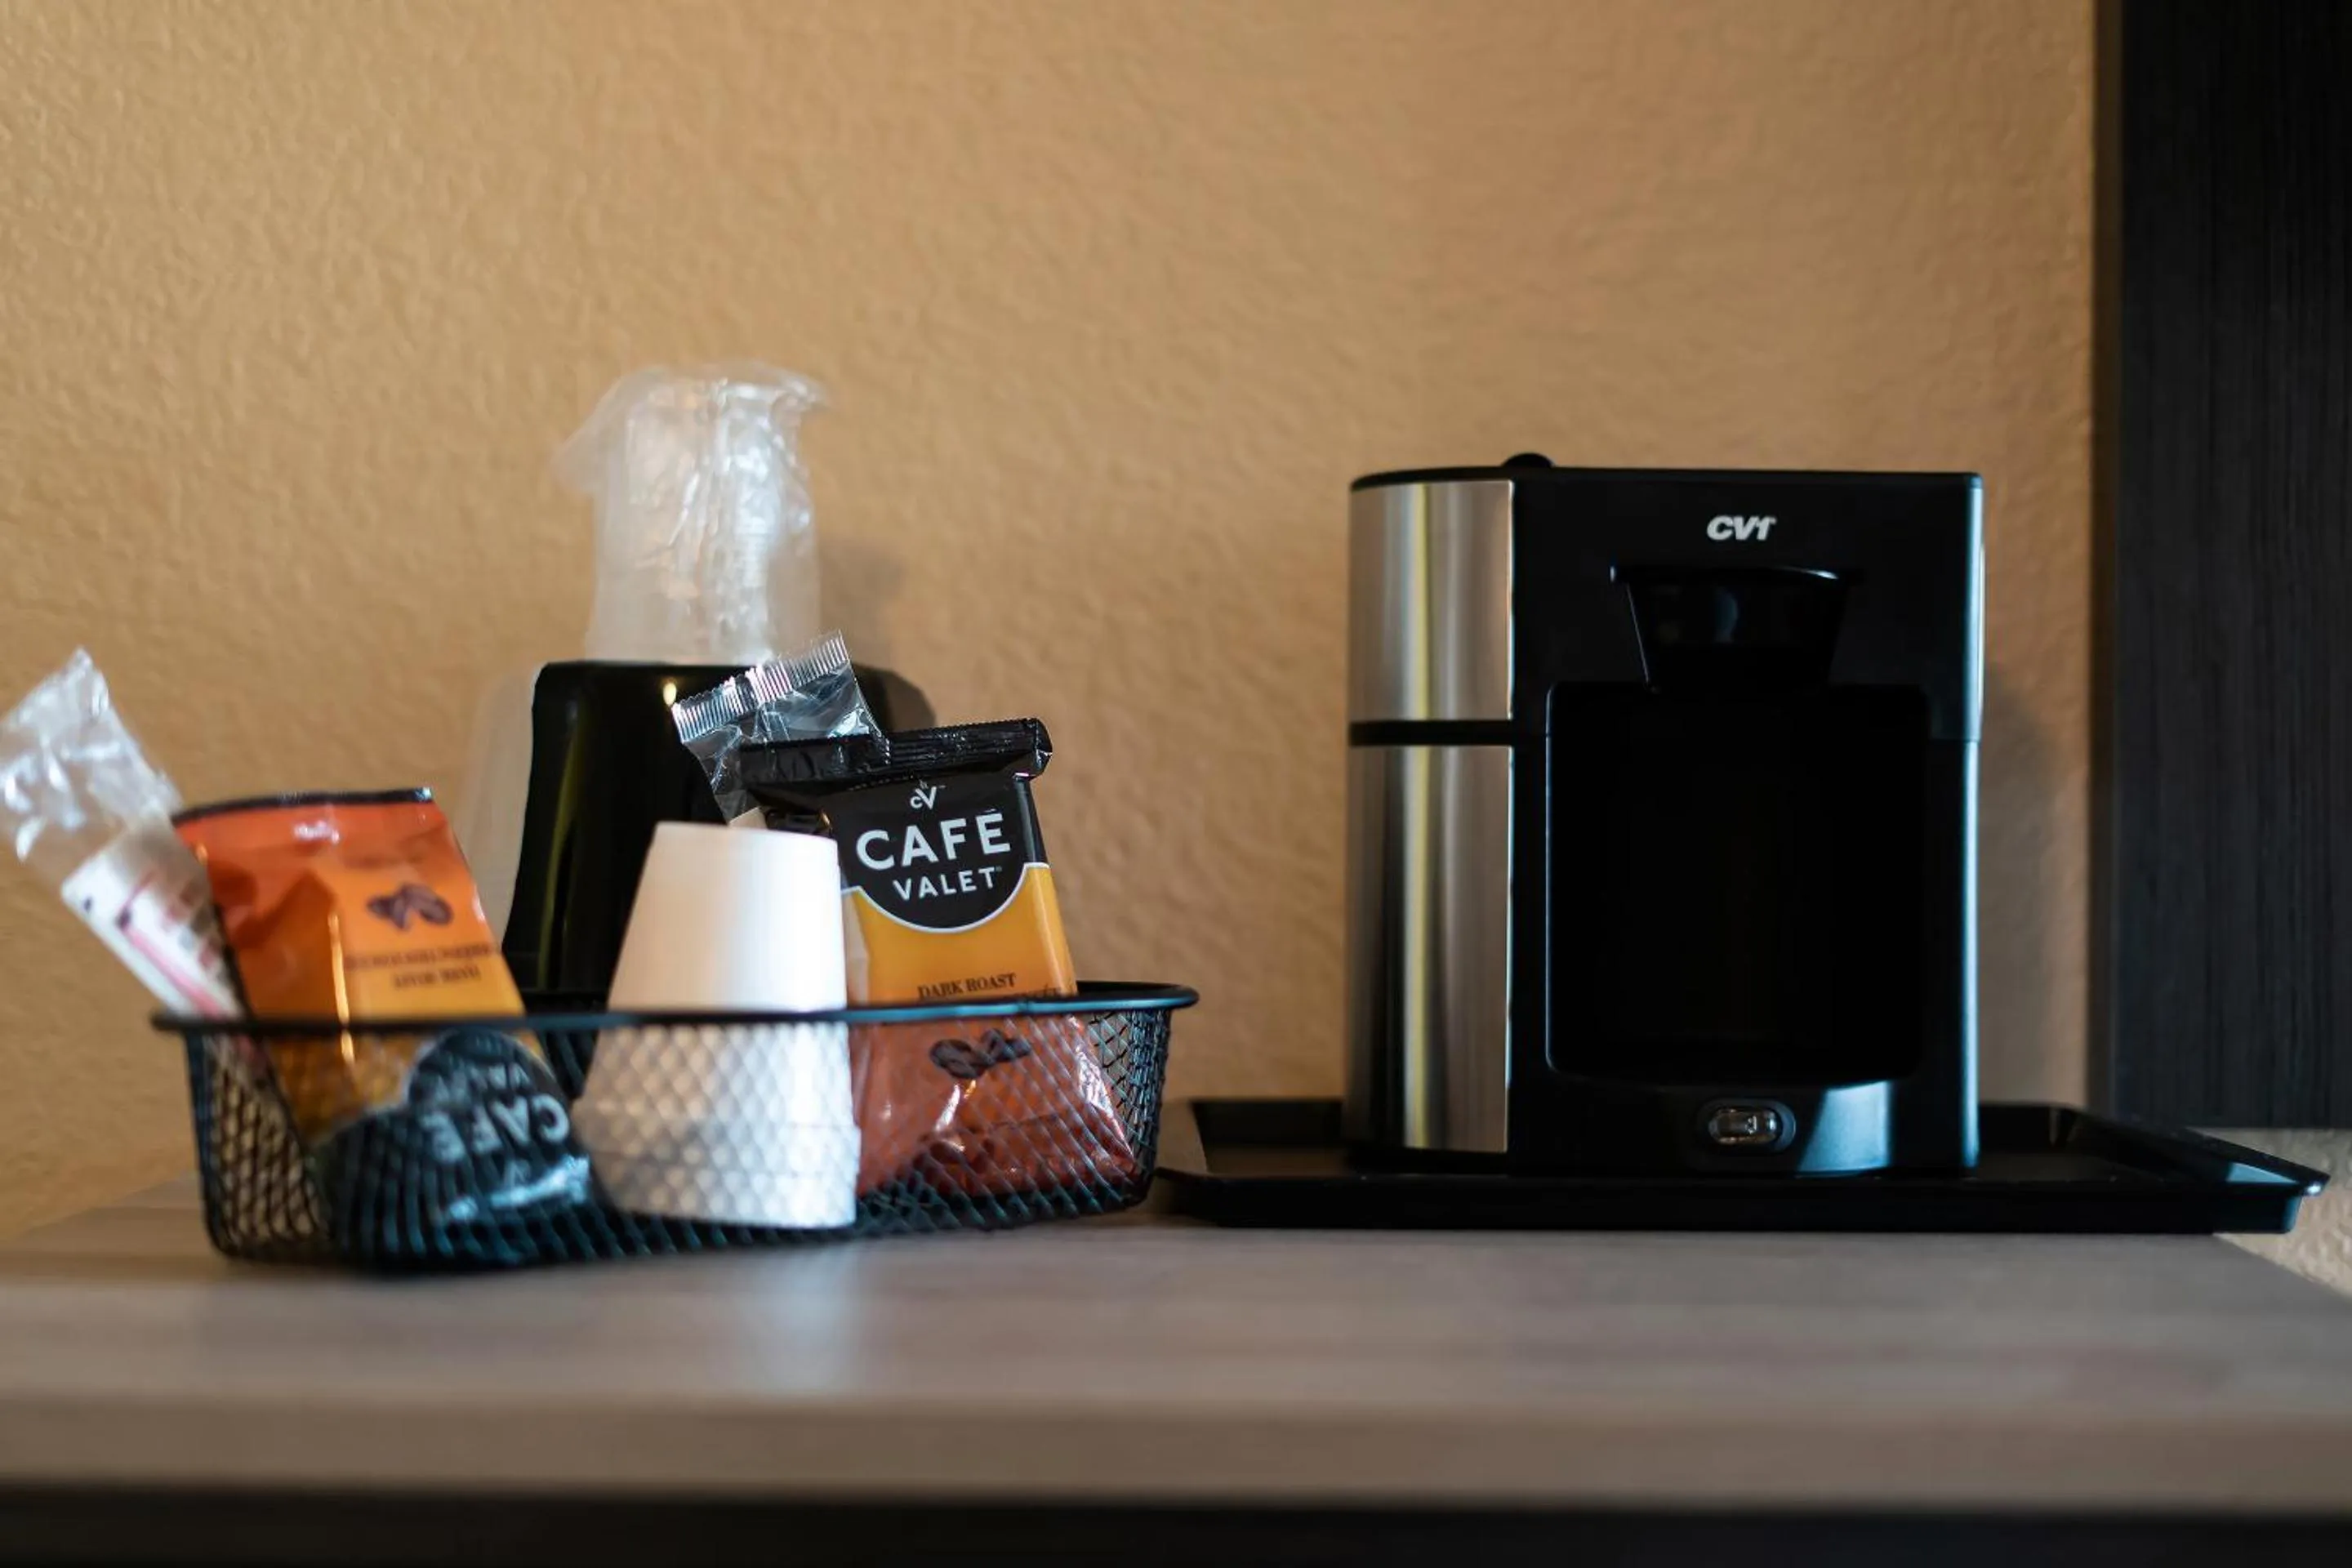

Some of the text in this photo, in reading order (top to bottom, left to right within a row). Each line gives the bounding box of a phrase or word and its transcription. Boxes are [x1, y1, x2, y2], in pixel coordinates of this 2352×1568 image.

[893, 866, 996, 900] VALET
[917, 979, 964, 1000] DARK
[966, 972, 1018, 992] ROAST
